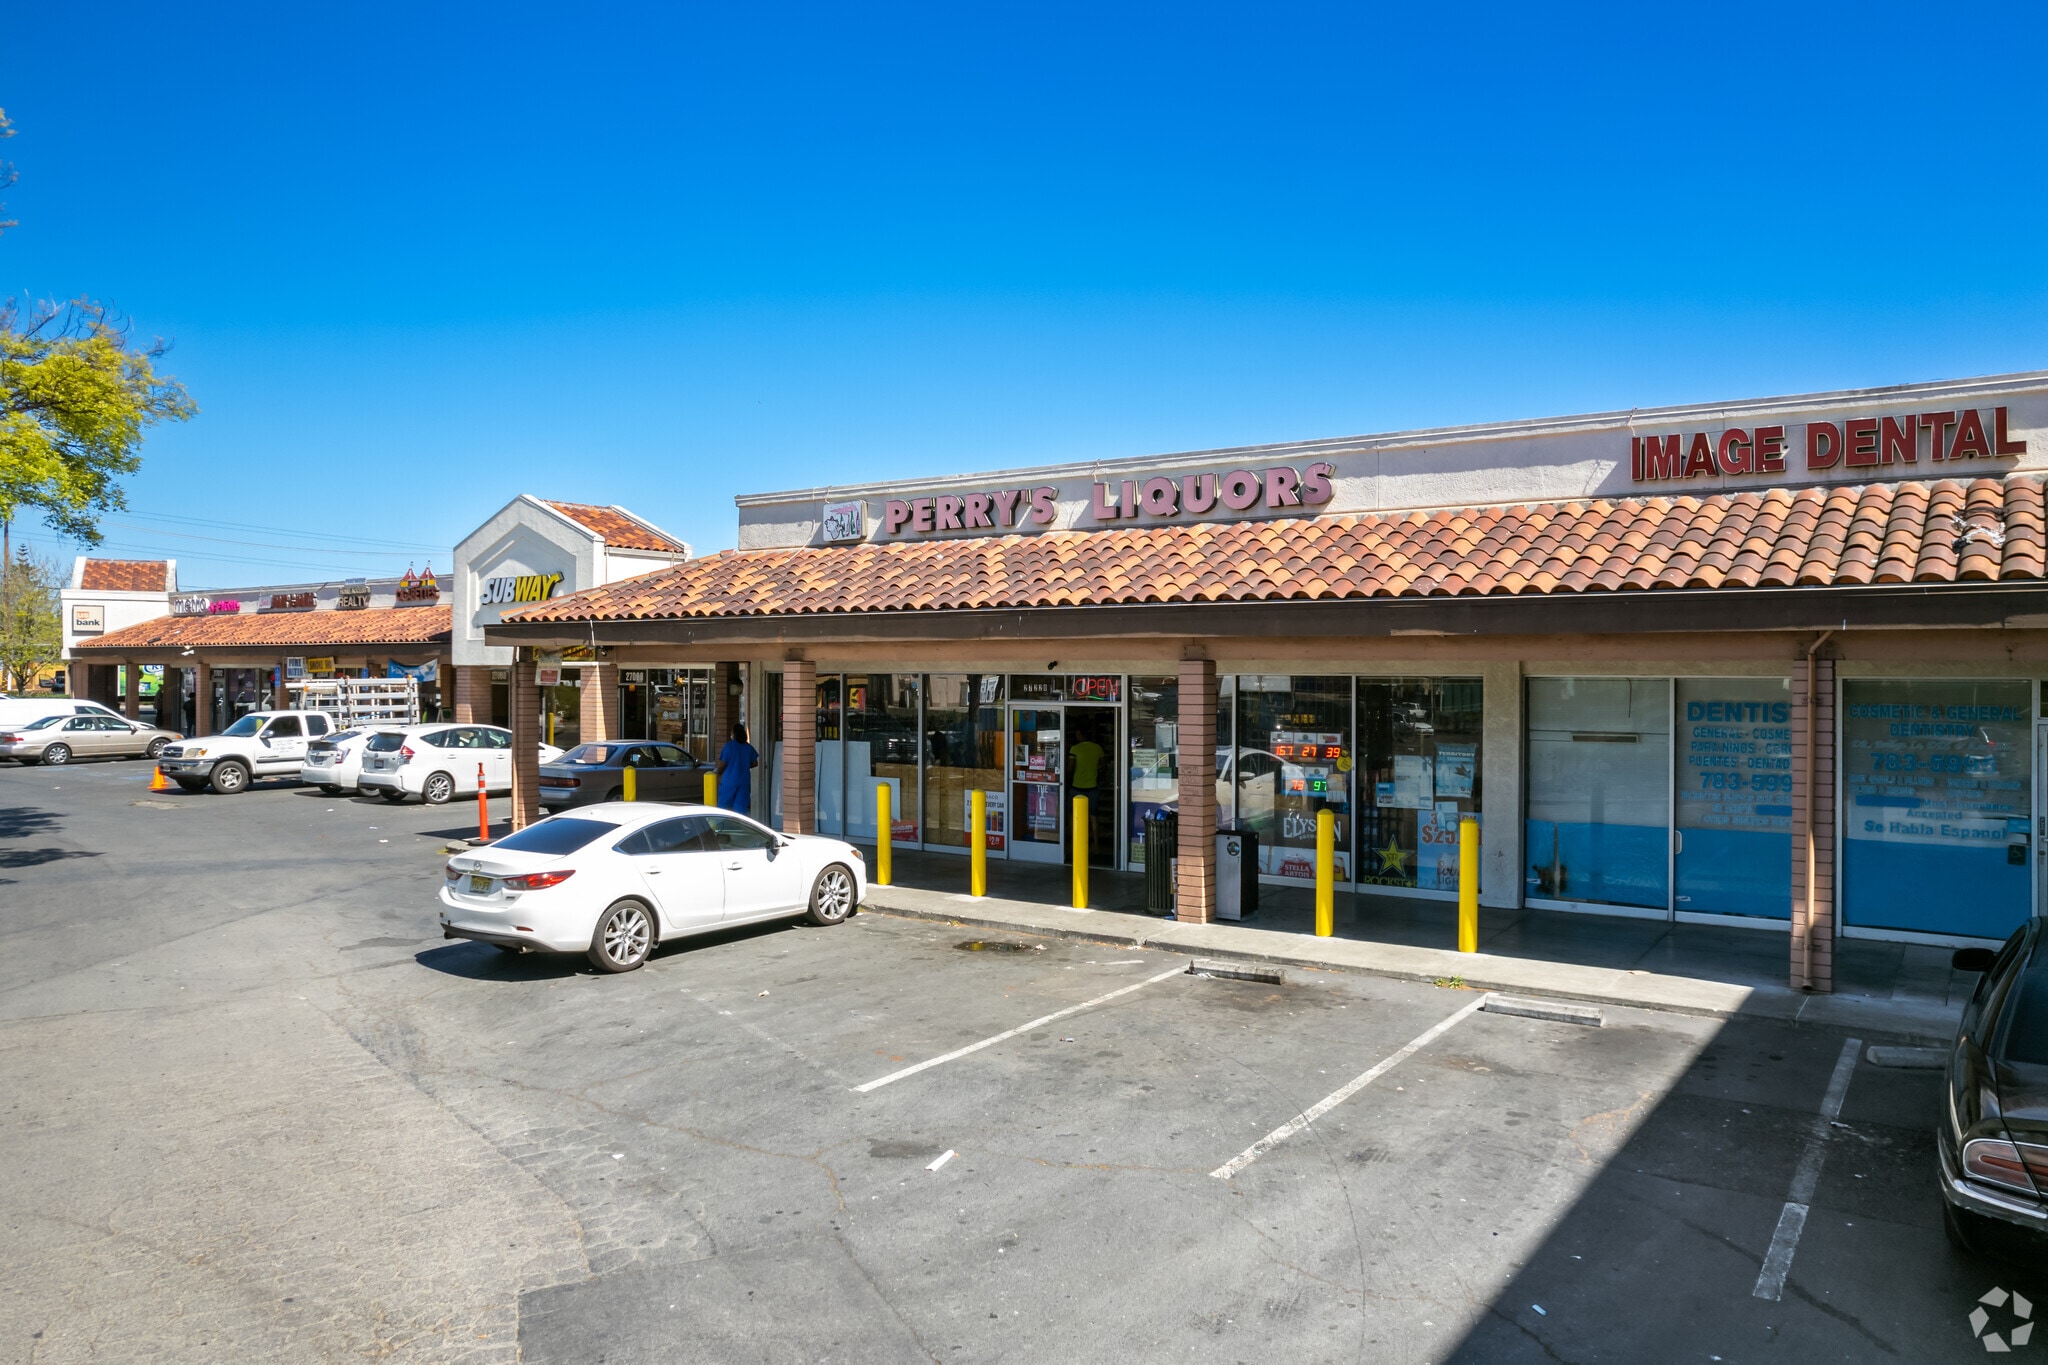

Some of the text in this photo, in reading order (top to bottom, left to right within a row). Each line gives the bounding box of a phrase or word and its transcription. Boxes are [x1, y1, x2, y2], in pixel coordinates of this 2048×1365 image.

[1631, 406, 2028, 481] IMAGE DENTAL
[885, 461, 1336, 534] PERRY'S LIQUORS
[480, 571, 565, 605] SUBWAY
[174, 594, 210, 613] metro
[338, 595, 368, 608] REALTY
[1074, 677, 1119, 696] OPEN
[1687, 701, 1792, 723] DENTIS
[1849, 703, 2022, 721] COSMETIC & GENERAL
[1693, 727, 1742, 739] GENERAL
[1752, 728, 1792, 740] COSME
[1889, 723, 1976, 737] DENTISTRY
[1301, 746, 1317, 757] 27
[1325, 747, 1341, 758] 39
[1691, 741, 1719, 752] PARA
[1722, 742, 1755, 754] NINOS
[1688, 755, 1737, 768] PUENTES
[1747, 757, 1791, 769] DENTAD
[1699, 772, 1792, 792] 783-599
[1922, 799, 1948, 808] Most
[1906, 809, 1963, 820] Accepted
[1283, 816, 1342, 842] ELYSN
[1863, 820, 1884, 833] Se
[1889, 821, 1934, 836] Habla
[1940, 824, 2008, 840] Espanol
[1284, 864, 1310, 872] STELLA
[1284, 870, 1310, 878] ARTOIS
